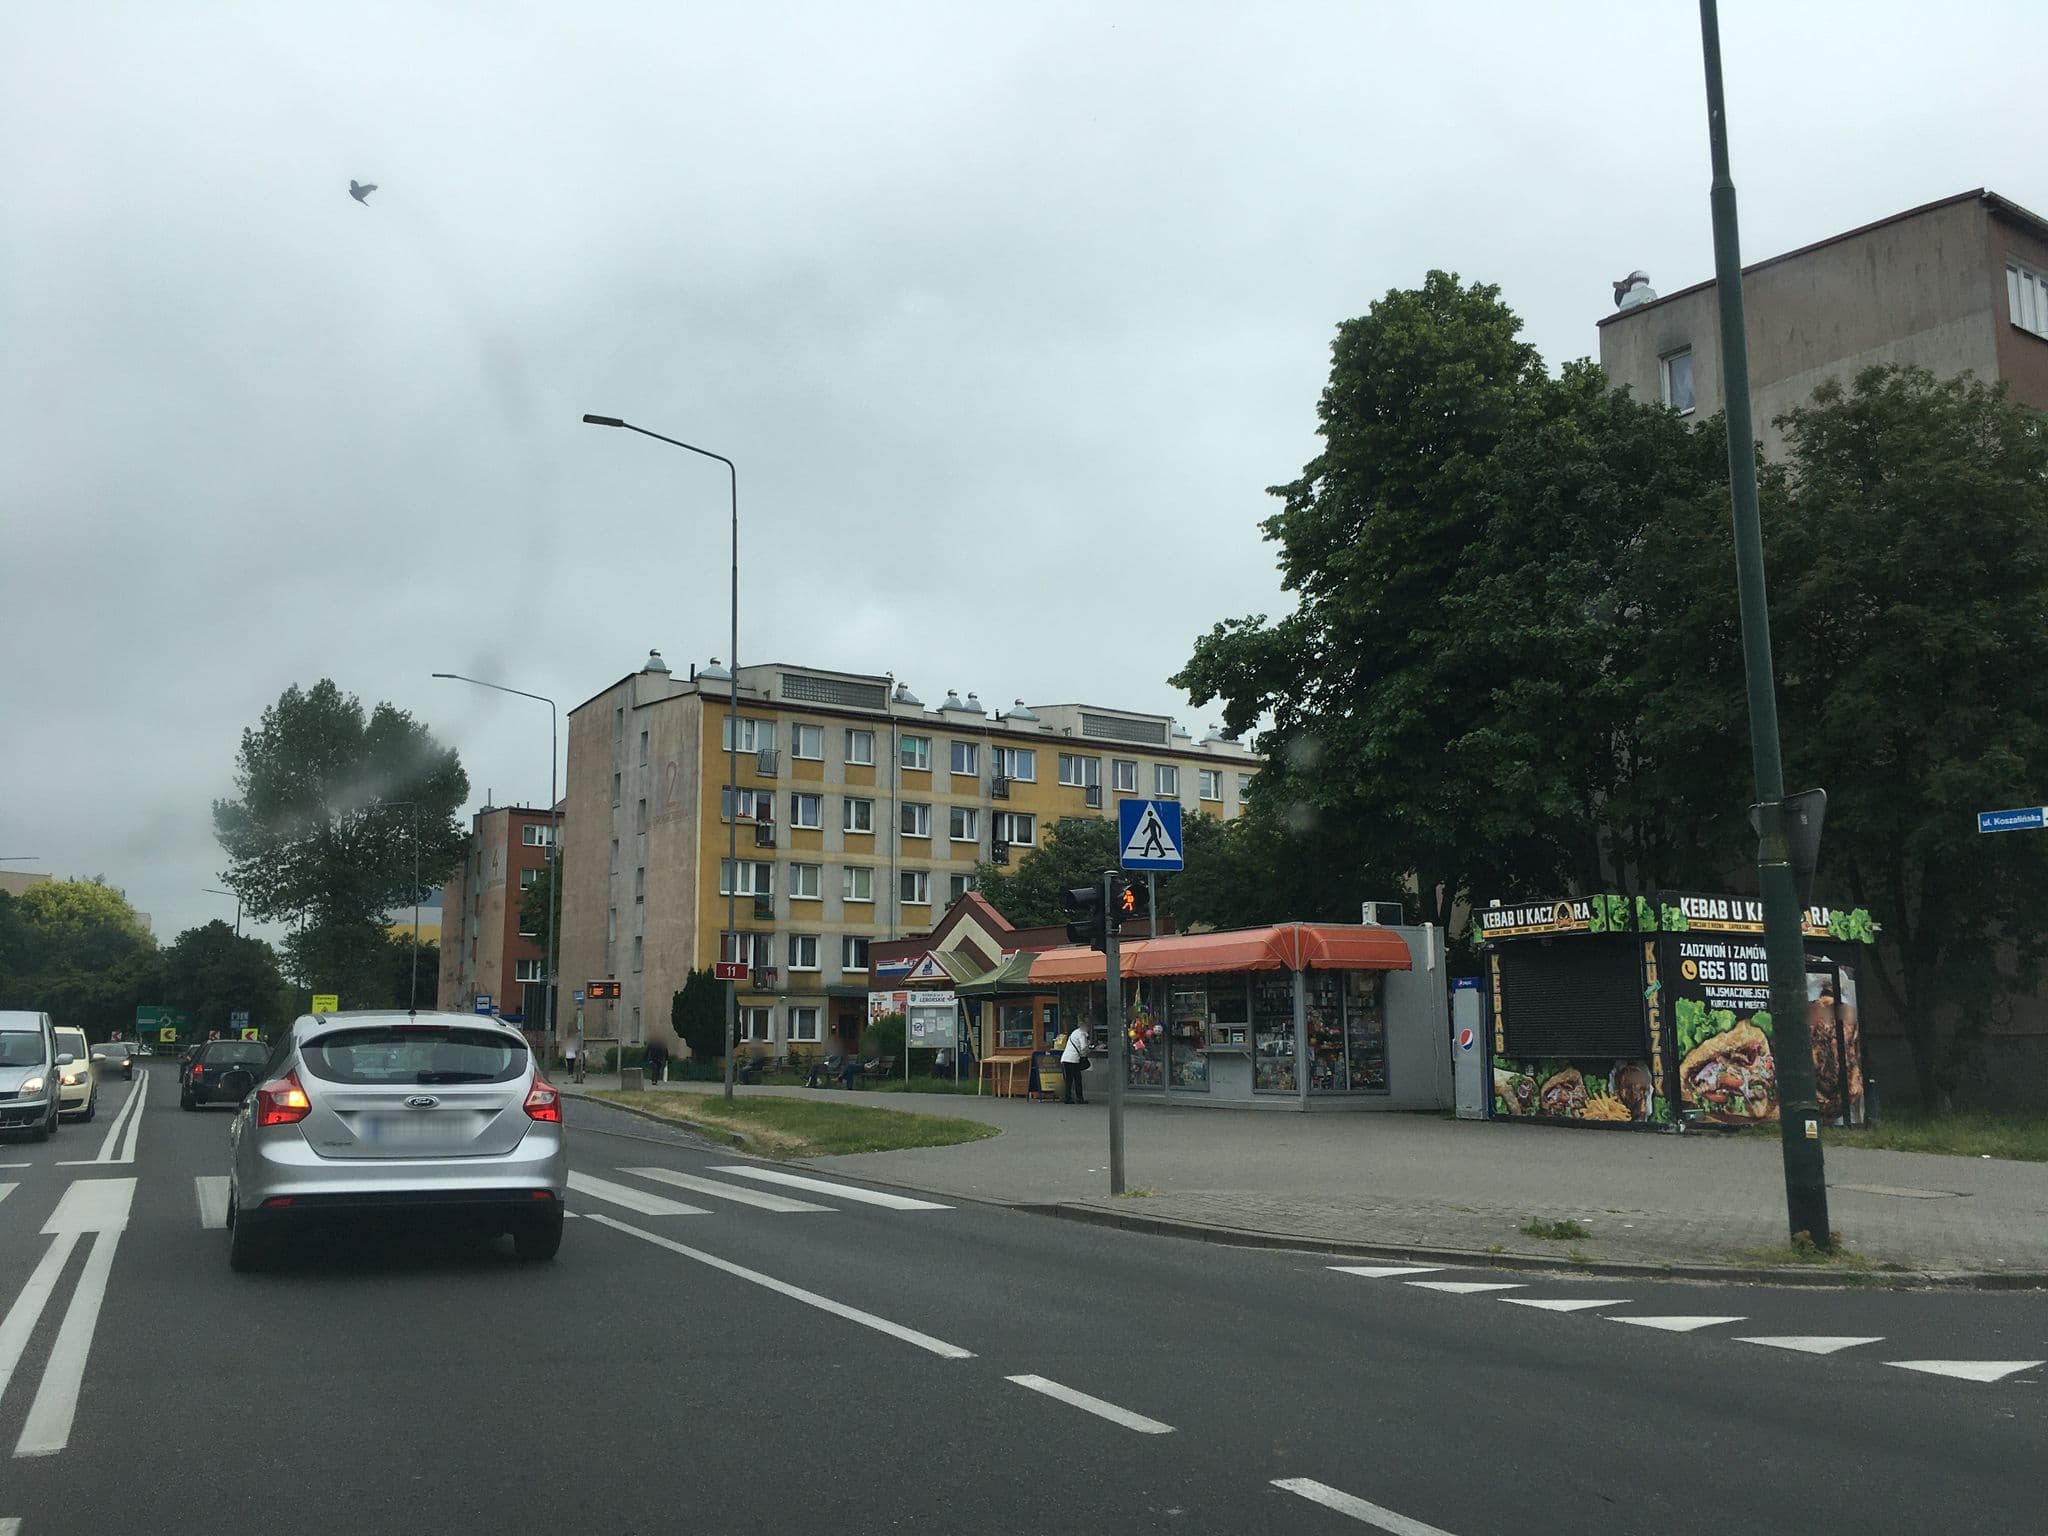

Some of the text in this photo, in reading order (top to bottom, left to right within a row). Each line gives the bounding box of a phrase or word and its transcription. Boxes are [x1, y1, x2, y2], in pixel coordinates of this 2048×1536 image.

[1680, 897, 1729, 919] KEBAB
[1731, 901, 1742, 920] U
[1482, 910, 1515, 929] KEBAB
[1516, 909, 1524, 925] U
[1680, 942, 1767, 960] ZADZWOŃ I ZAMÓW
[726, 966, 736, 977] 11
[1699, 960, 1769, 982] 665 118 011
[1705, 986, 1770, 999] NAJSMACZNIEJSZY
[1491, 954, 1504, 1053] KEBAB
[1710, 999, 1737, 1009] KURCZAK
[1738, 1000, 1744, 1009] W
